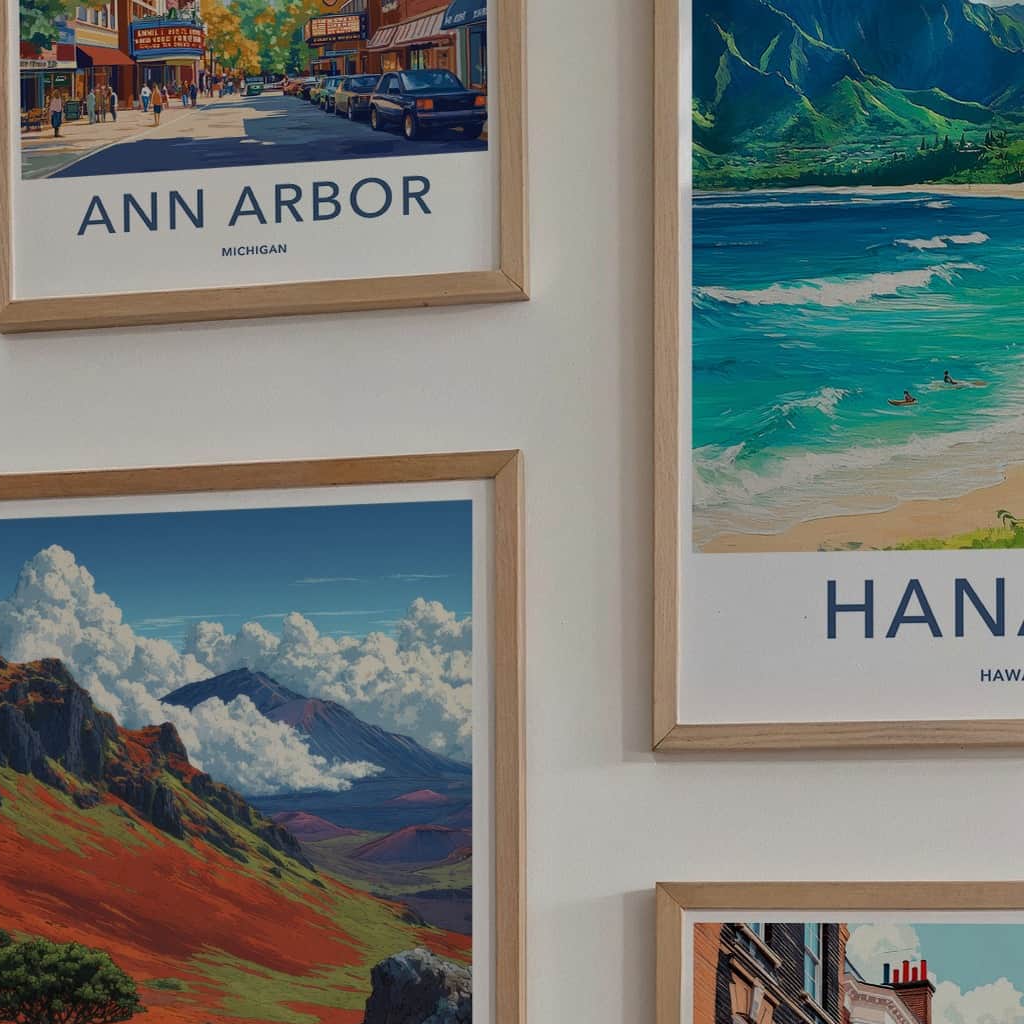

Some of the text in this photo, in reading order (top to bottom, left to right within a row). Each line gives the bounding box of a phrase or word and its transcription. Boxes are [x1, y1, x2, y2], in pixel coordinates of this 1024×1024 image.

[77, 175, 432, 236] ANN ARBOR
[221, 244, 287, 257] MICHIGAN
[827, 577, 1024, 639] HAN
[980, 668, 1024, 682] HAW
